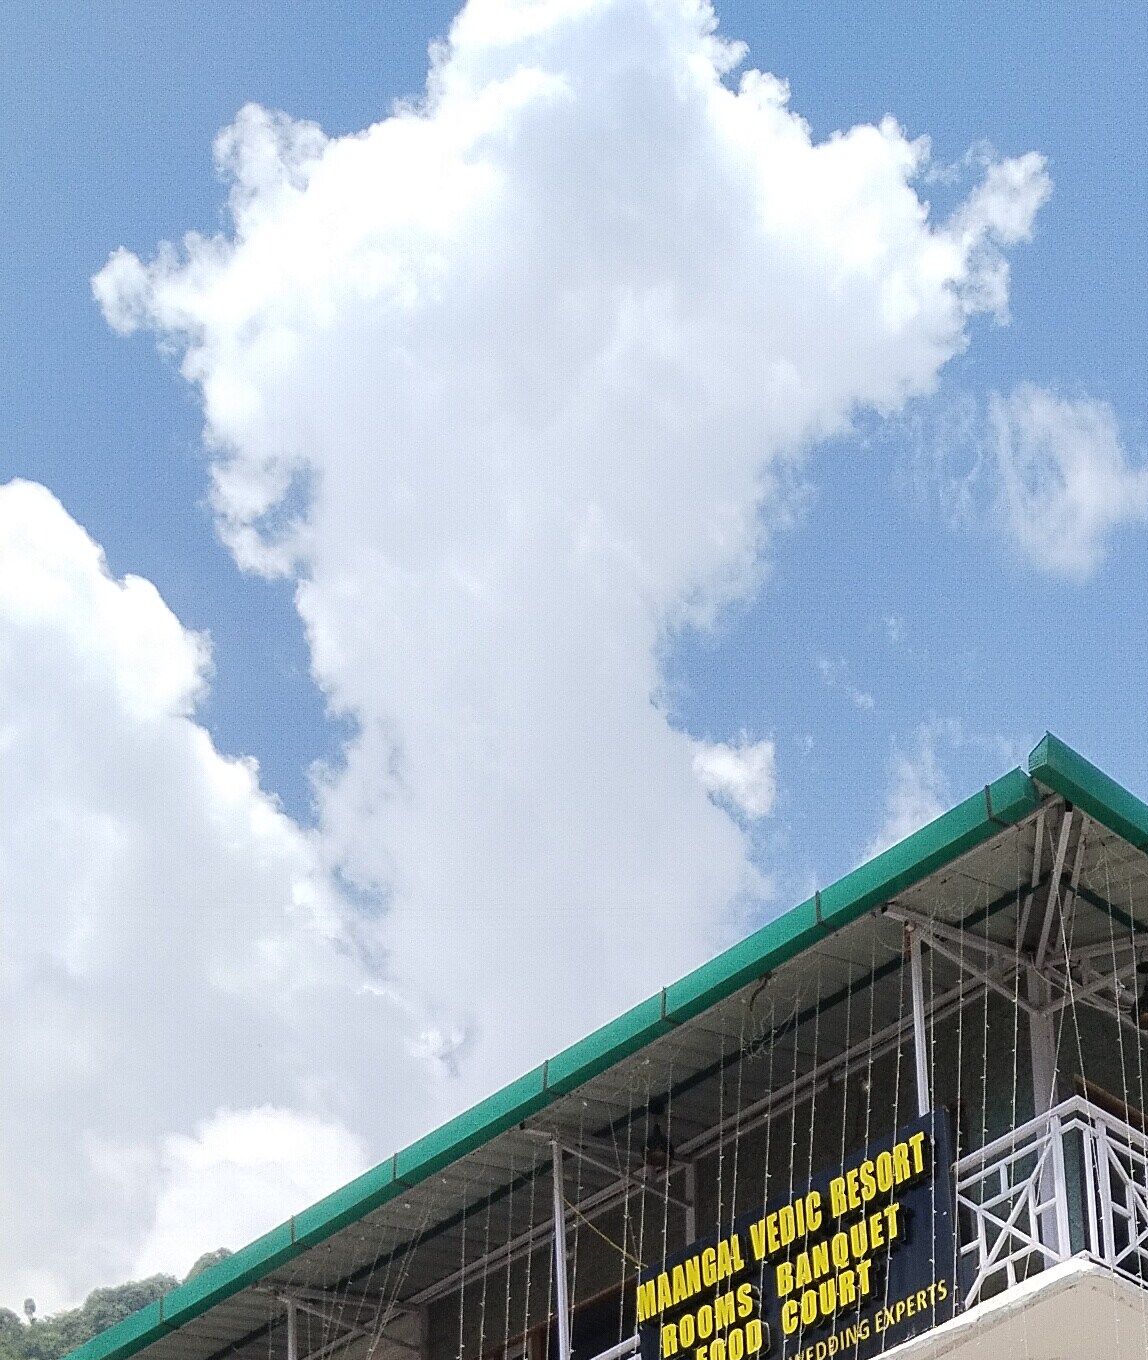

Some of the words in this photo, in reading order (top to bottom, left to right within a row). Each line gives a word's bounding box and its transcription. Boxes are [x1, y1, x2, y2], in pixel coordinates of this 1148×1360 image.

[637, 1233, 745, 1323] MAANGAL
[750, 1190, 823, 1261] VEDIC
[829, 1131, 926, 1218] RESORT
[661, 1282, 753, 1359] ROOMS
[776, 1202, 900, 1298] BANQUET
[781, 1259, 873, 1337] COURT
[875, 1279, 948, 1334] EXPERTS
